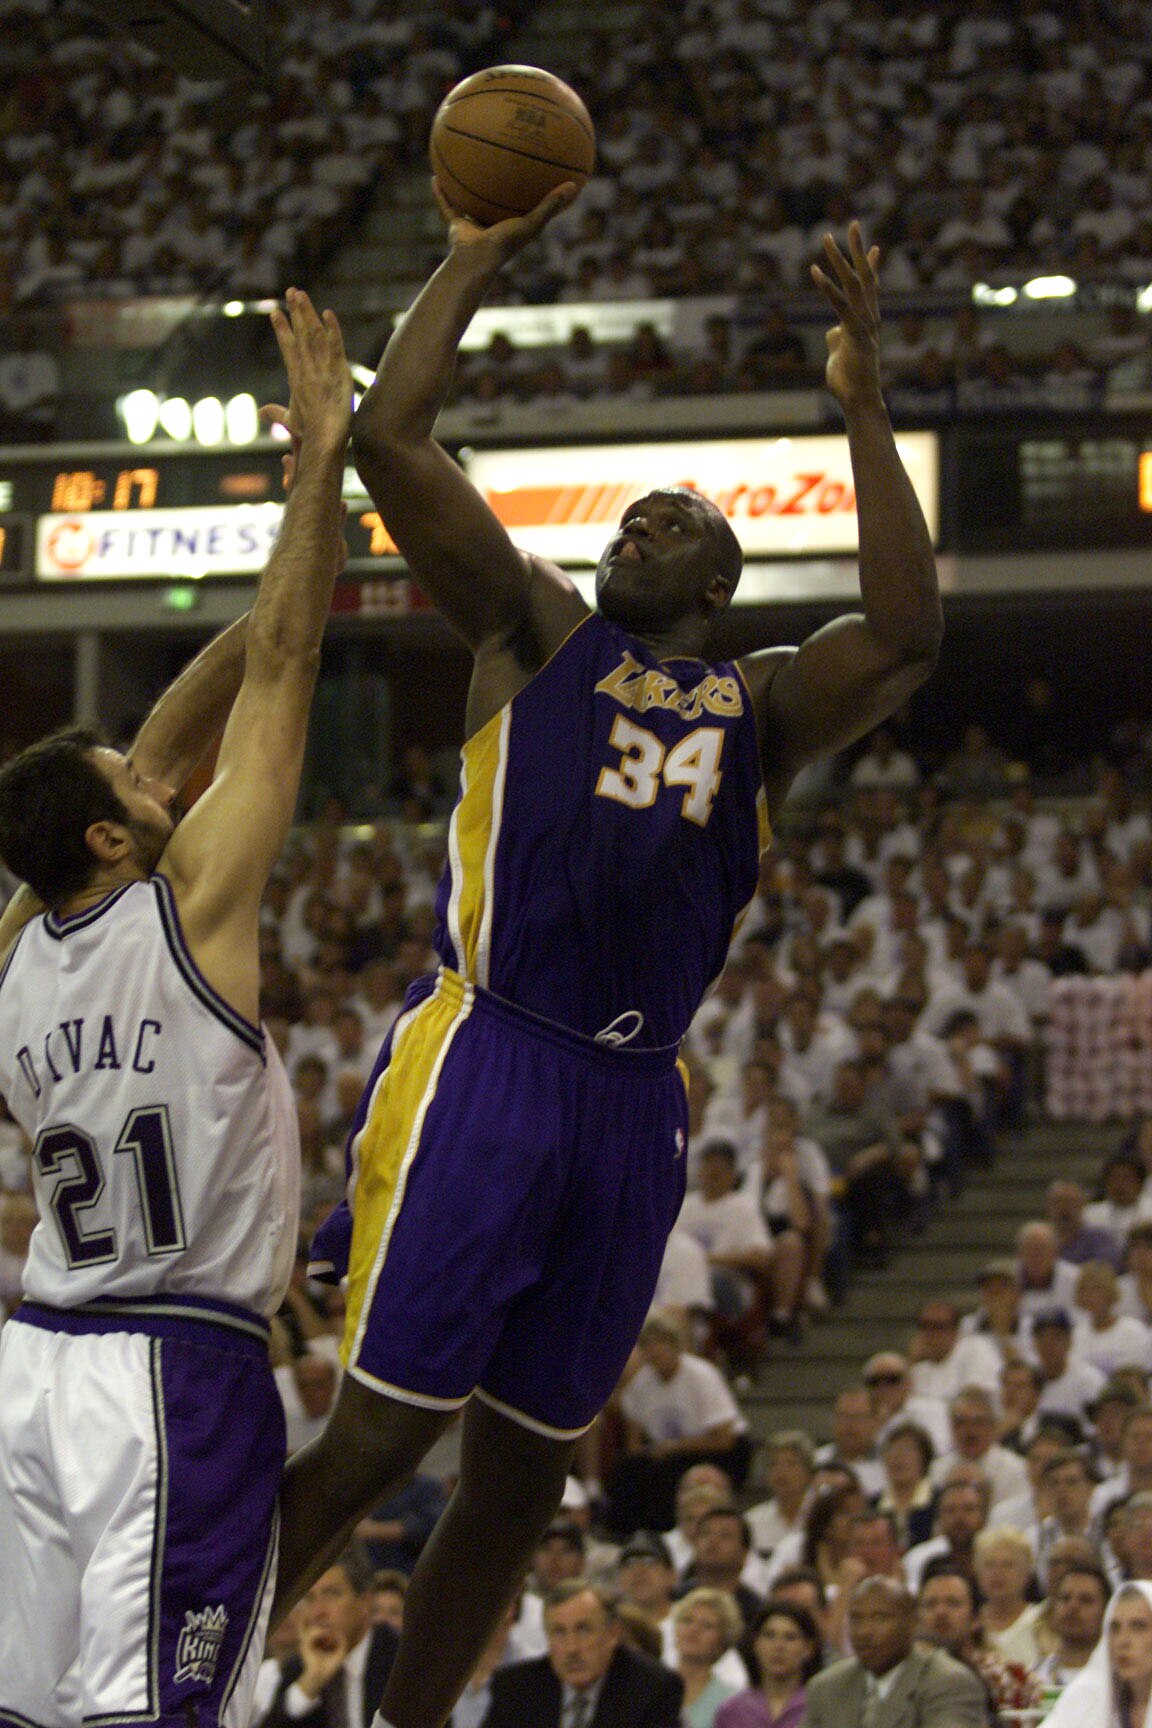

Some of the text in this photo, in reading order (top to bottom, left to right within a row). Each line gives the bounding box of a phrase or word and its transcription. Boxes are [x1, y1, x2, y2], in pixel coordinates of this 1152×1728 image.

[595, 712, 726, 828] 34
[16, 1014, 162, 1100] DIVAC
[33, 1103, 187, 1271] 21
